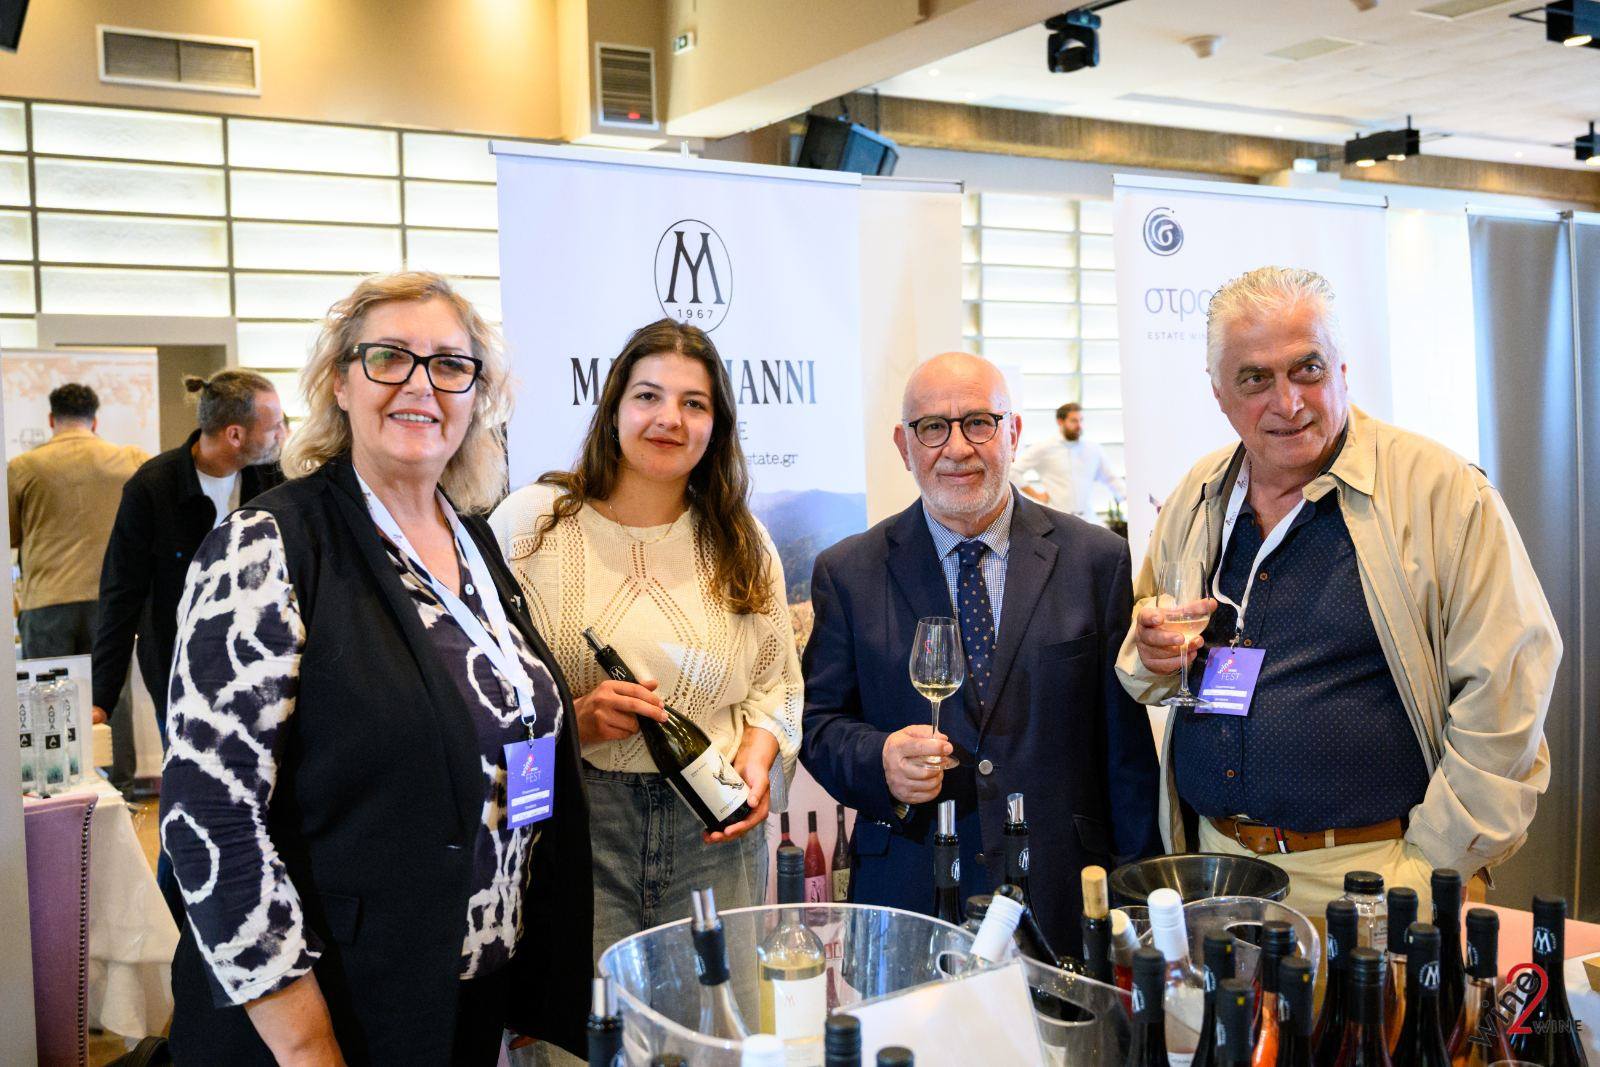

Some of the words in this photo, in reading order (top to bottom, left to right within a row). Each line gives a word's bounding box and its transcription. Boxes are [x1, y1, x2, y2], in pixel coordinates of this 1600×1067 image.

[678, 309, 713, 319] 1967
[1147, 331, 1186, 341] ESTATE
[19, 703, 27, 729] AQUA
[48, 704, 56, 730] AQUA
